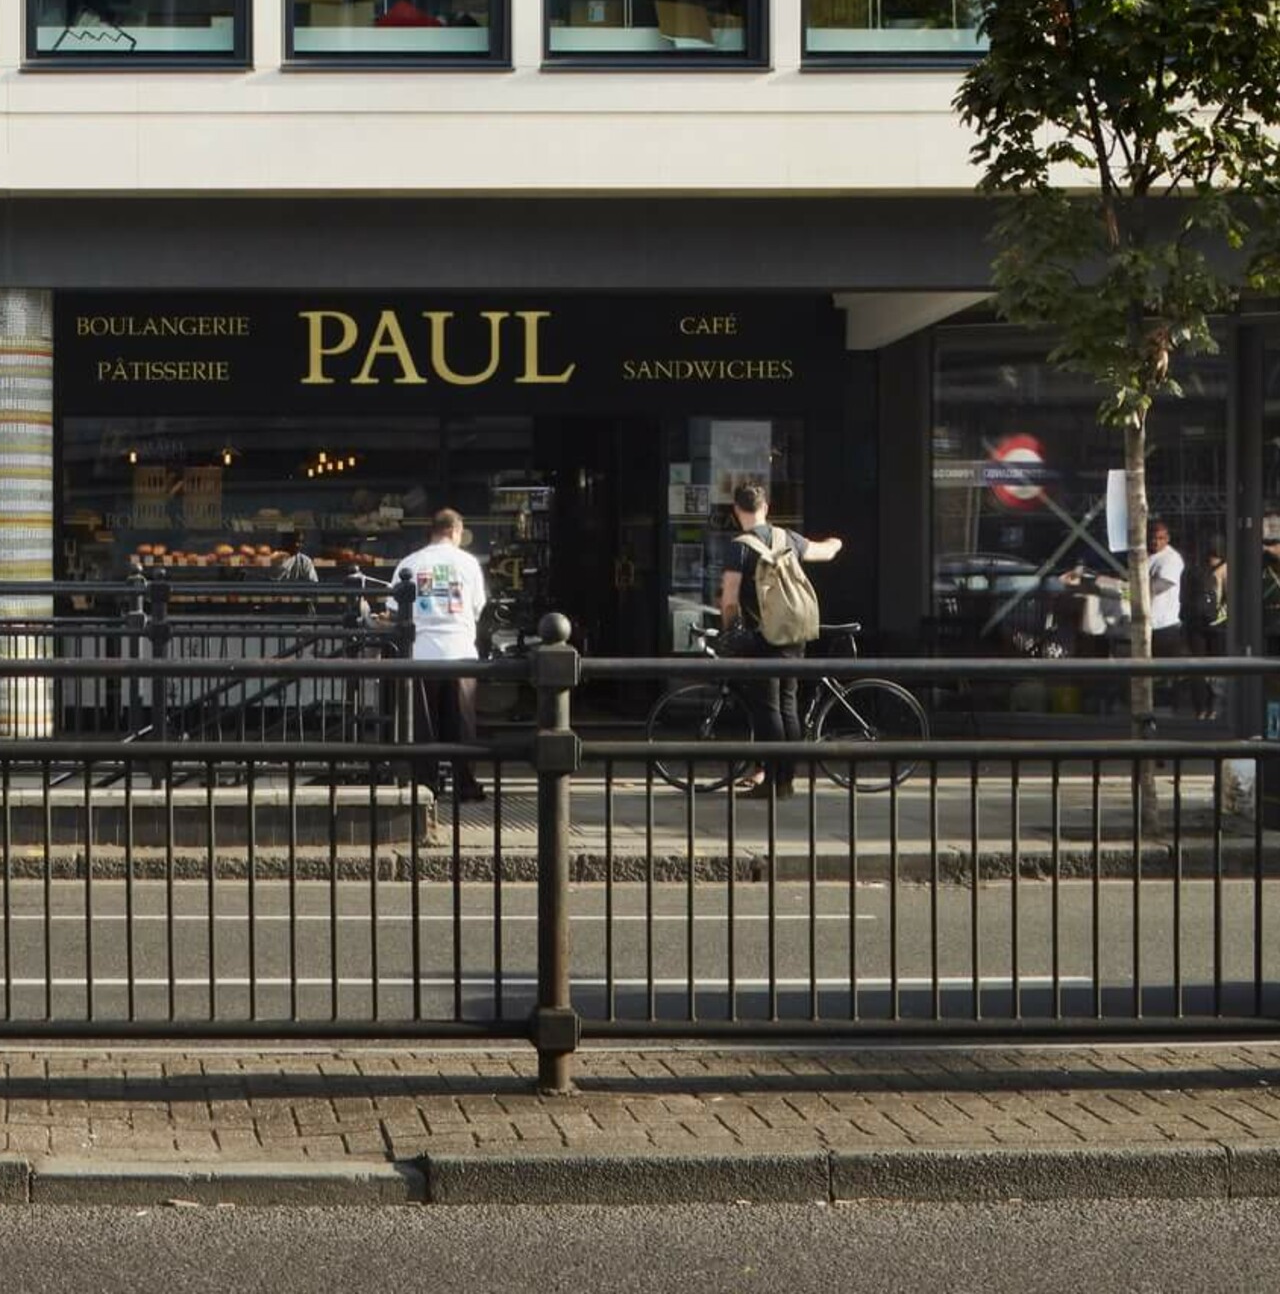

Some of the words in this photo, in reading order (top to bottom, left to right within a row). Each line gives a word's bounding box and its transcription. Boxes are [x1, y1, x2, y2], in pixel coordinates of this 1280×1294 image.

[76, 315, 251, 336] BOULANGERIE
[679, 313, 738, 335] CAFÉ
[298, 310, 576, 386] PAUL
[97, 357, 231, 381] PÂTISSERIE
[622, 359, 794, 380] SANDWICHES
